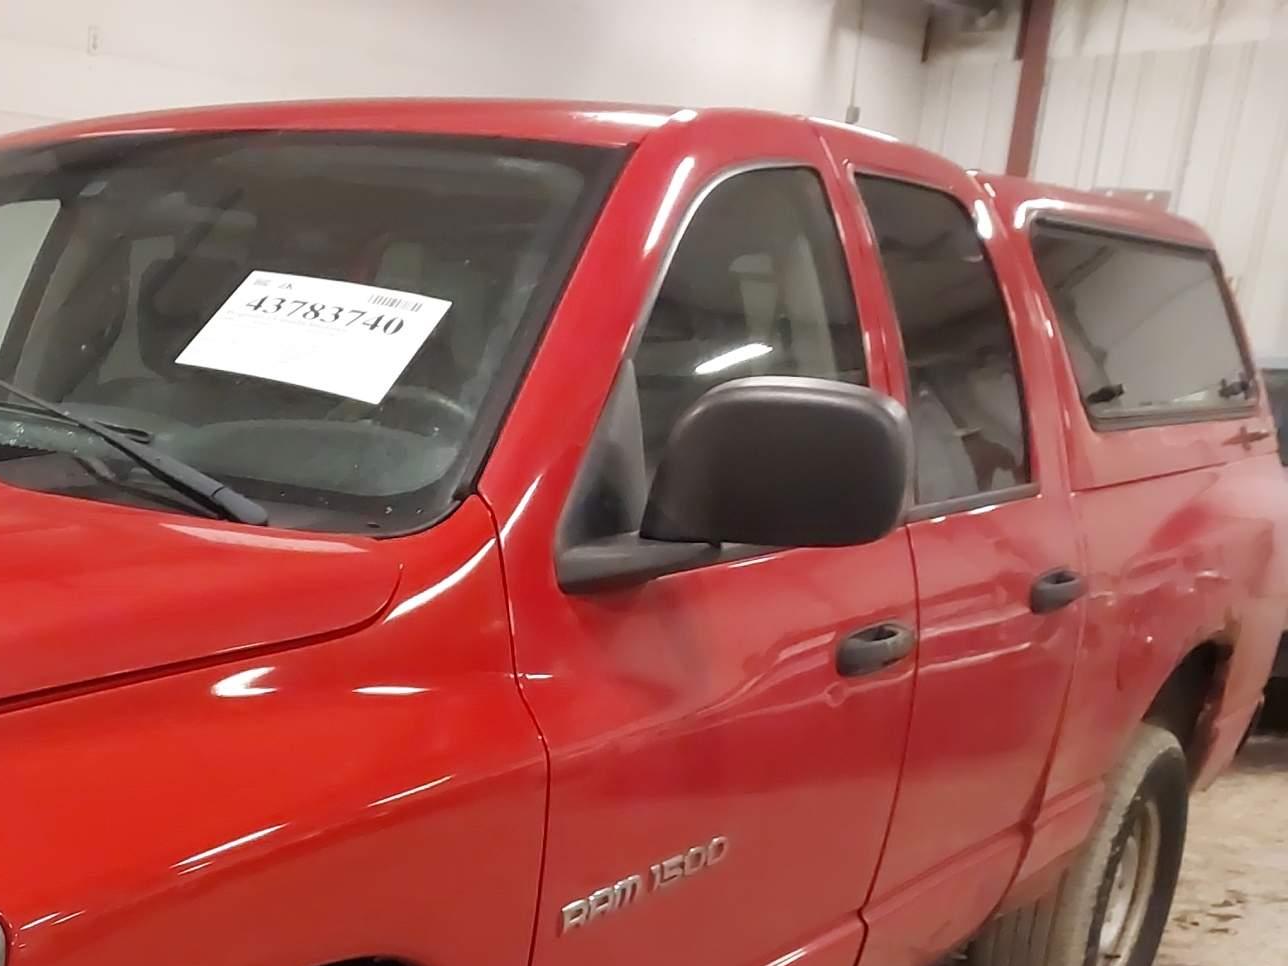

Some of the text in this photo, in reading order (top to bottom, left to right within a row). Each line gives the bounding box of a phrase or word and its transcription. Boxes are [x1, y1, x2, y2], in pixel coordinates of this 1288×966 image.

[245, 295, 405, 335] 43783740
[560, 835, 729, 934] RAM 1500
